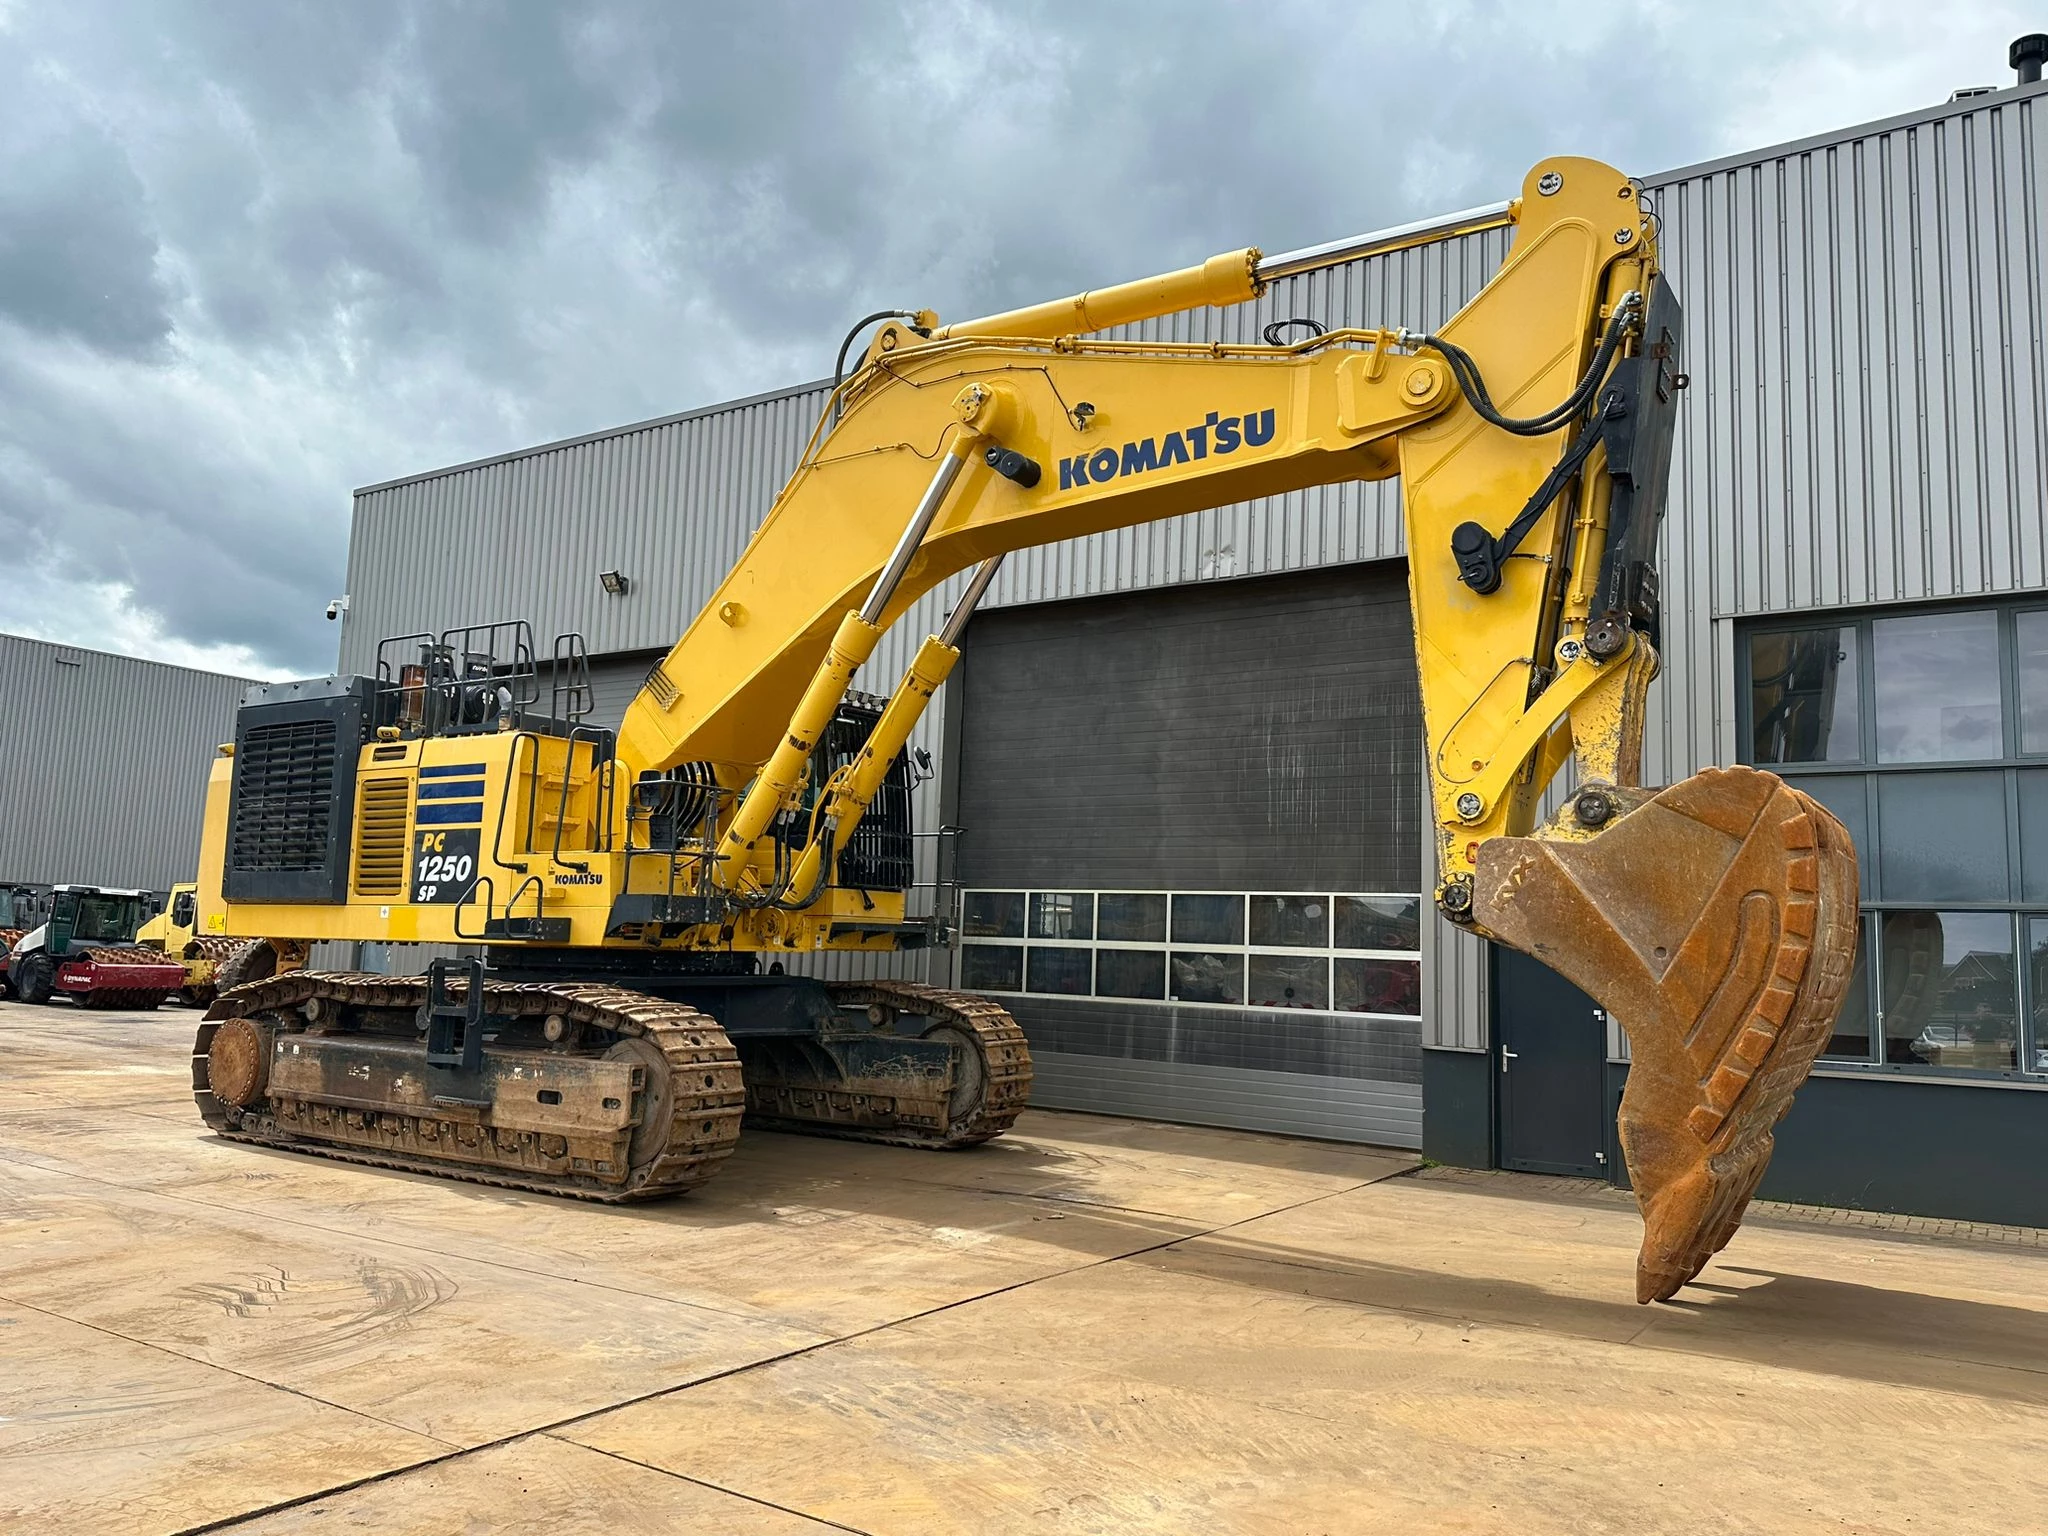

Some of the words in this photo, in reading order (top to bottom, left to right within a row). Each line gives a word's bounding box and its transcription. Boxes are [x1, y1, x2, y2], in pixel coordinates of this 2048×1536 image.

[1059, 408, 1275, 490] KOMATSU
[421, 832, 446, 852] PC
[418, 854, 472, 882] 1250
[555, 871, 603, 885] KOMATSU
[417, 885, 437, 902] SP
[67, 975, 92, 983] DYNAPAC
